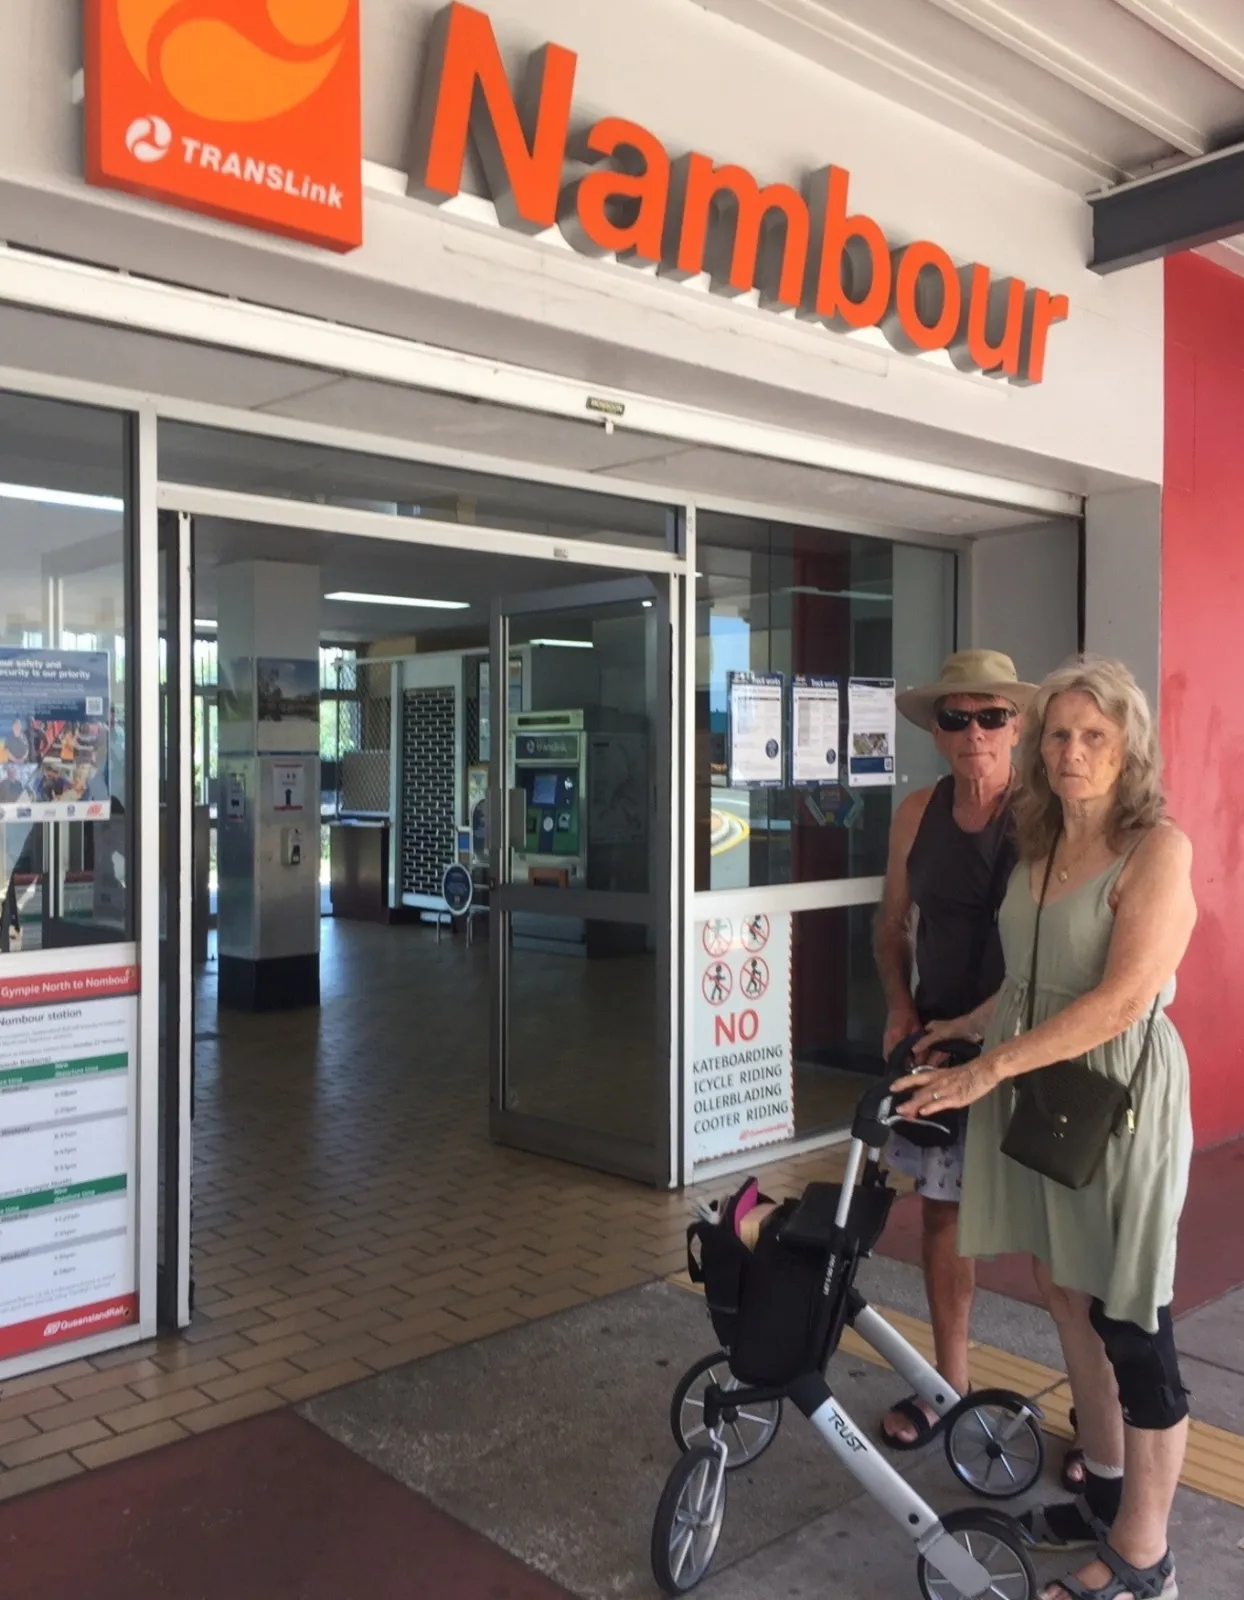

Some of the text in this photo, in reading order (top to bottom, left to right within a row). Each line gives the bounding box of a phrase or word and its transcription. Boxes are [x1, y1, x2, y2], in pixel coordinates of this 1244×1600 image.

[182, 137, 344, 209] TRANSLink
[416, 1, 1069, 386] Nambour
[16, 659, 43, 670] safety
[45, 660, 62, 669] and
[32, 669, 41, 677] is
[43, 670, 57, 678] our
[59, 670, 90, 681] priority
[1, 975, 129, 999] Gympie North to Nambour
[48, 1008, 82, 1021] station
[714, 1008, 759, 1047] NO
[740, 1064, 783, 1084] RIDING
[746, 1100, 789, 1122] RIDING
[828, 1407, 868, 1452] TRUST
